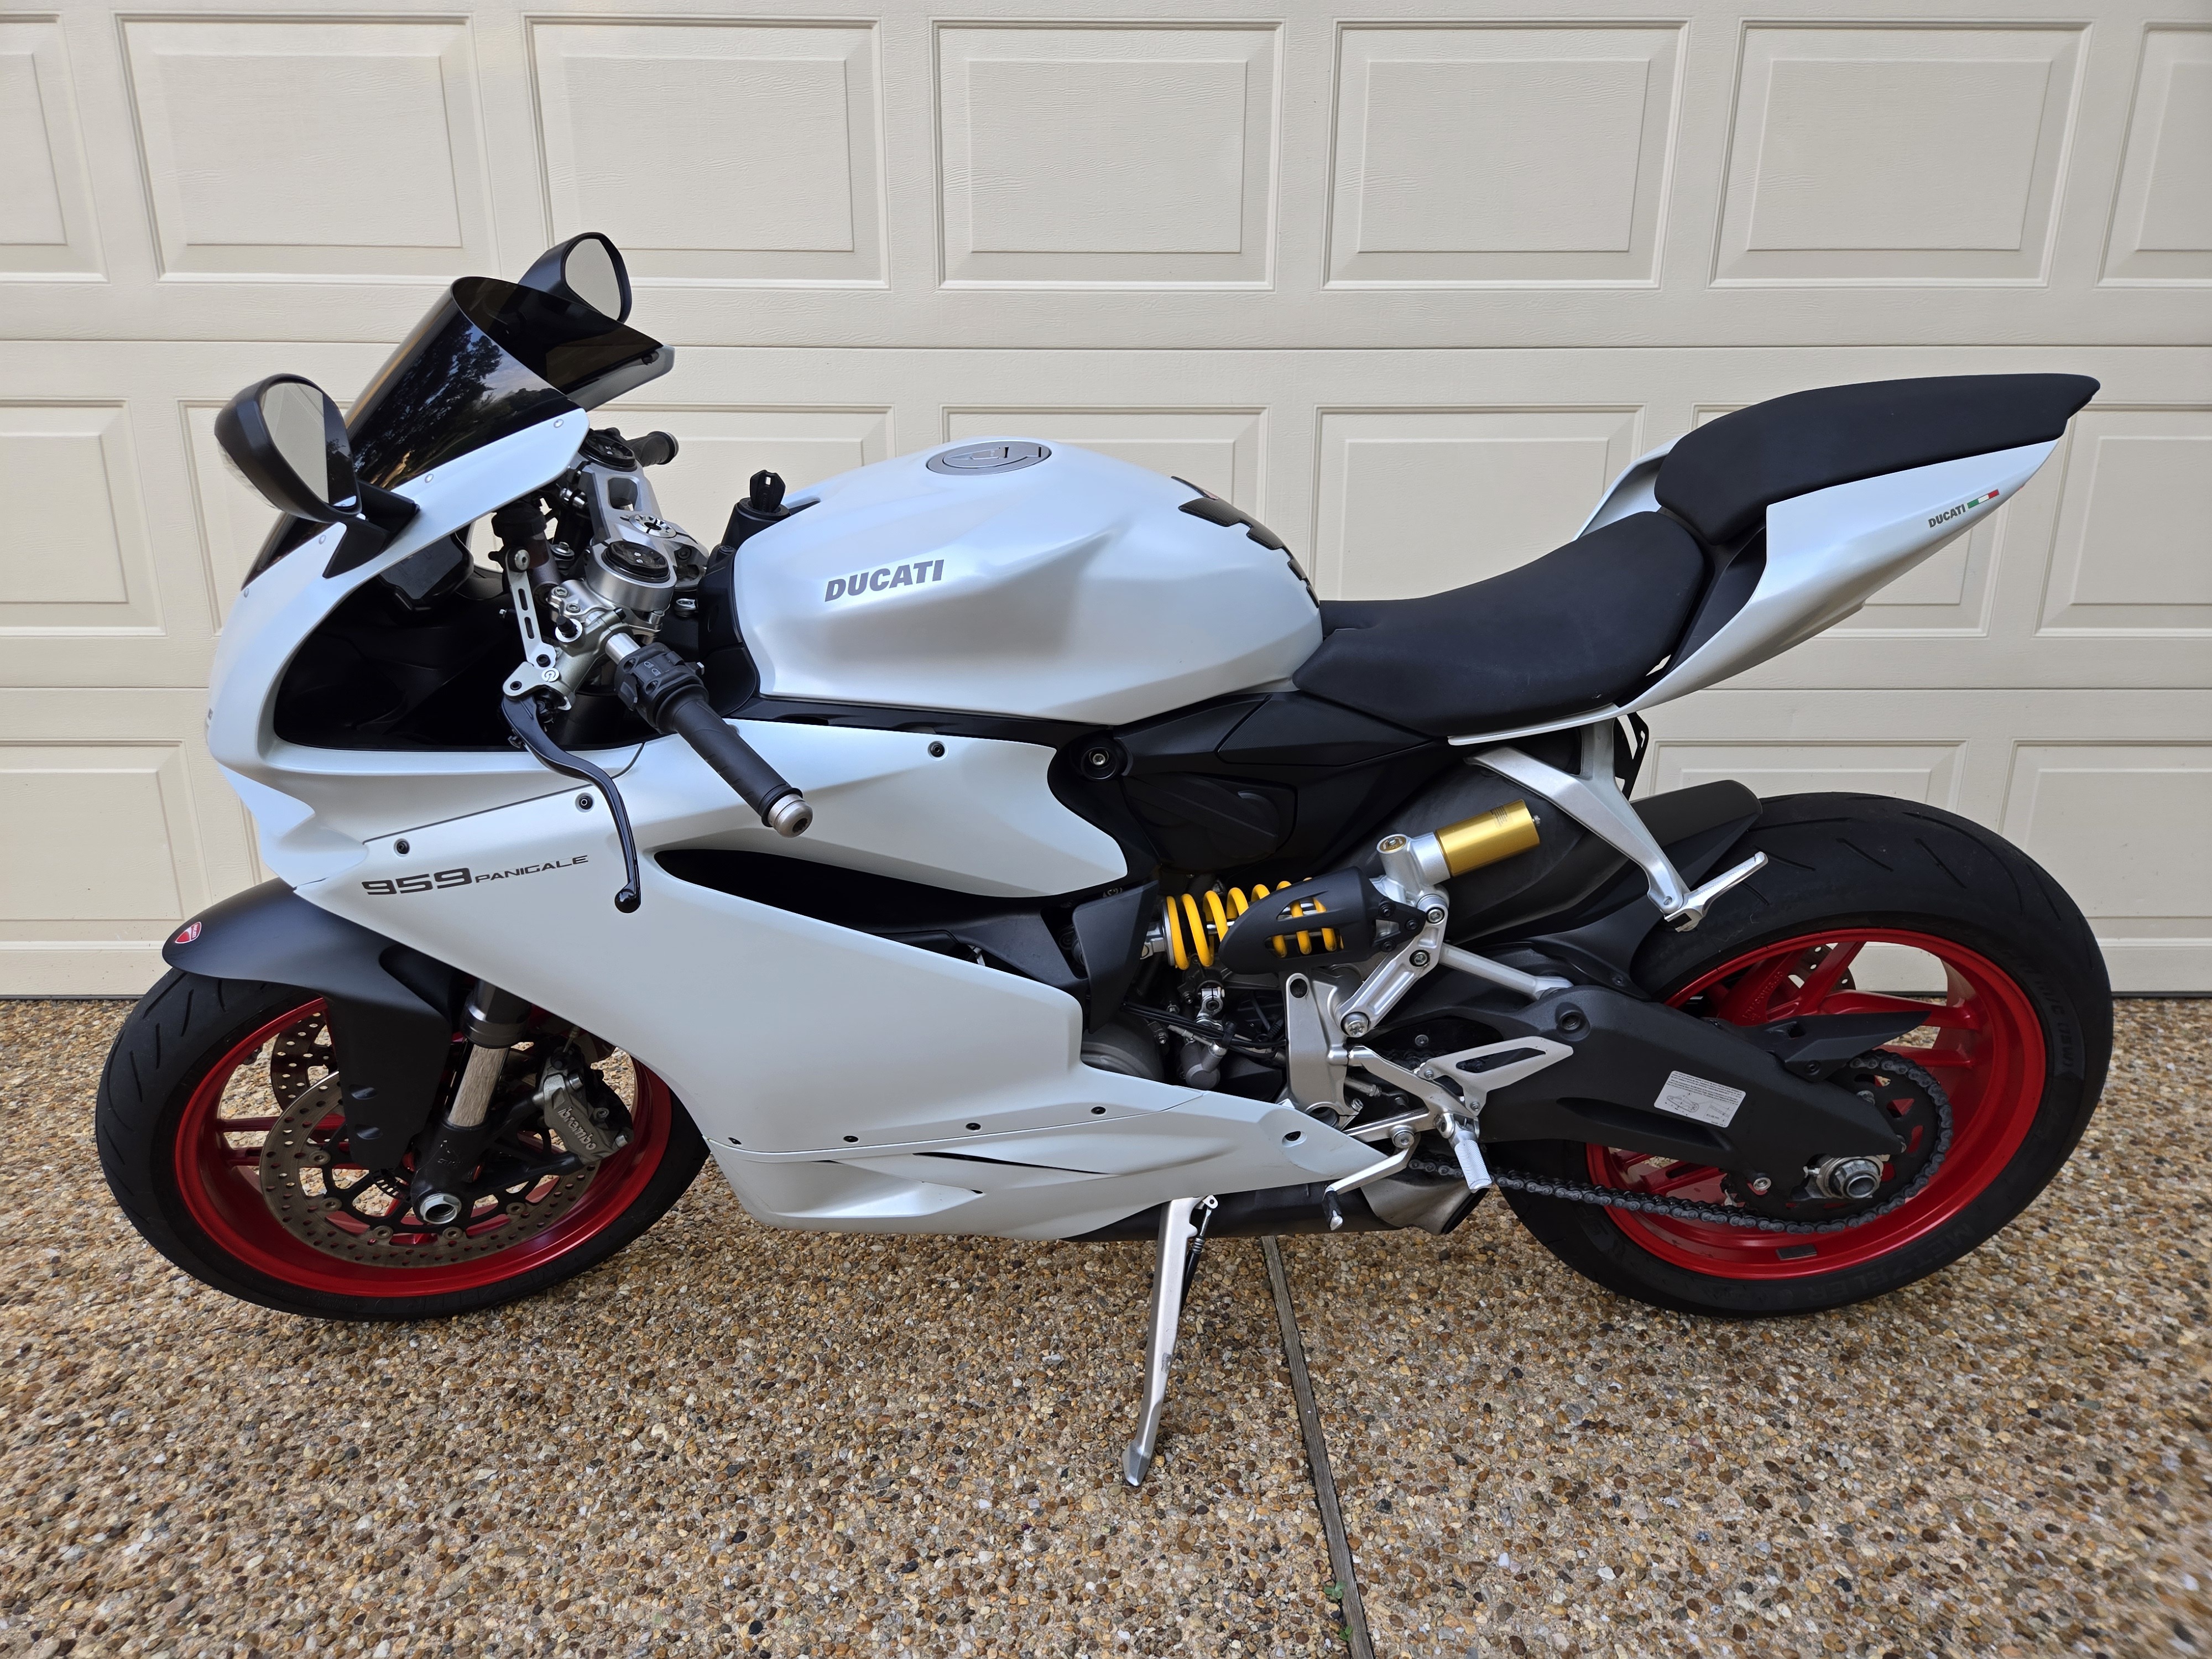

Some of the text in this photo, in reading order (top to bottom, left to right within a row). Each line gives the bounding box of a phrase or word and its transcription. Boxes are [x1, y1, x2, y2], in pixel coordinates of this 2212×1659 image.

[1928, 504, 1966, 528] DUCATI
[825, 559, 945, 602] DUCATI
[361, 855, 589, 895] 959 PANIGALE
[557, 1107, 597, 1150] brembo
[1807, 1221, 1975, 1302] METZELER
